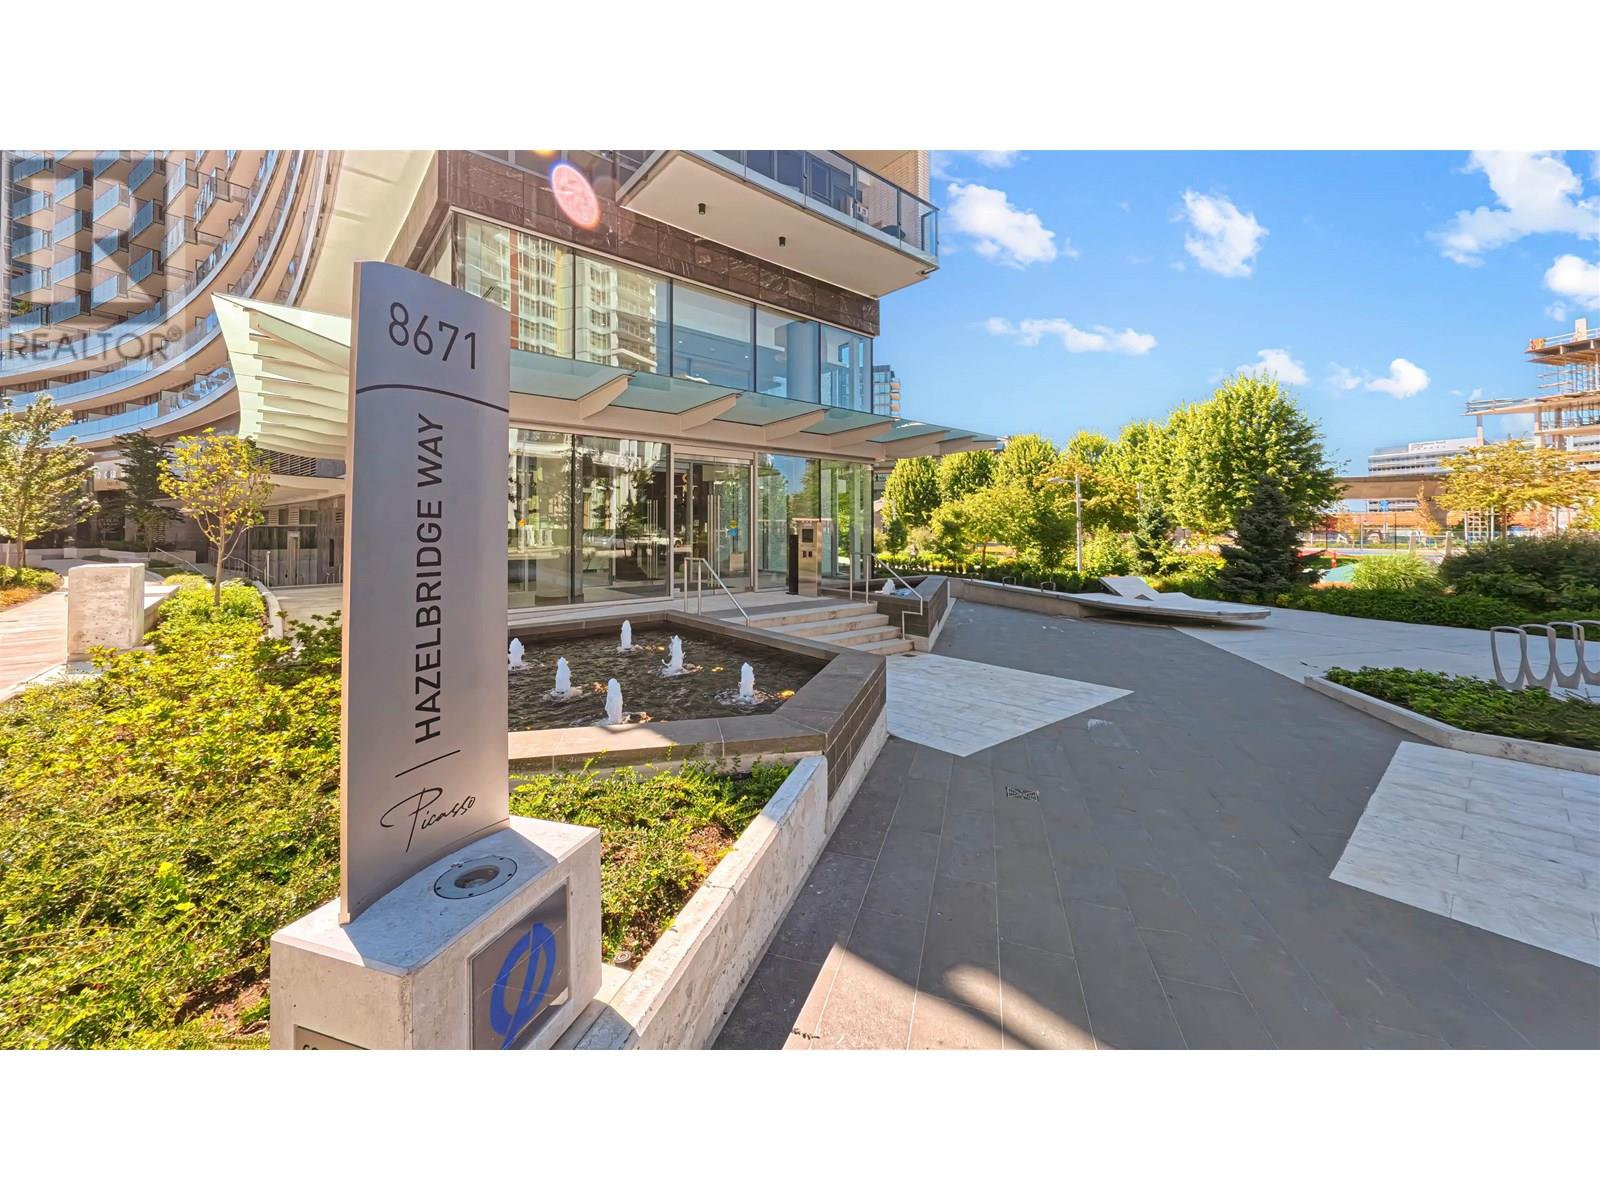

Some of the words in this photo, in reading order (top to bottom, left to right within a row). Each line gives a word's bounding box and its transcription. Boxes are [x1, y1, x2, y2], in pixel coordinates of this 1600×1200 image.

[388, 302, 476, 369] 8671
[416, 413, 443, 488] WAY
[415, 499, 442, 744] HAZELBRIDGE
[380, 787, 476, 853] Picasso
